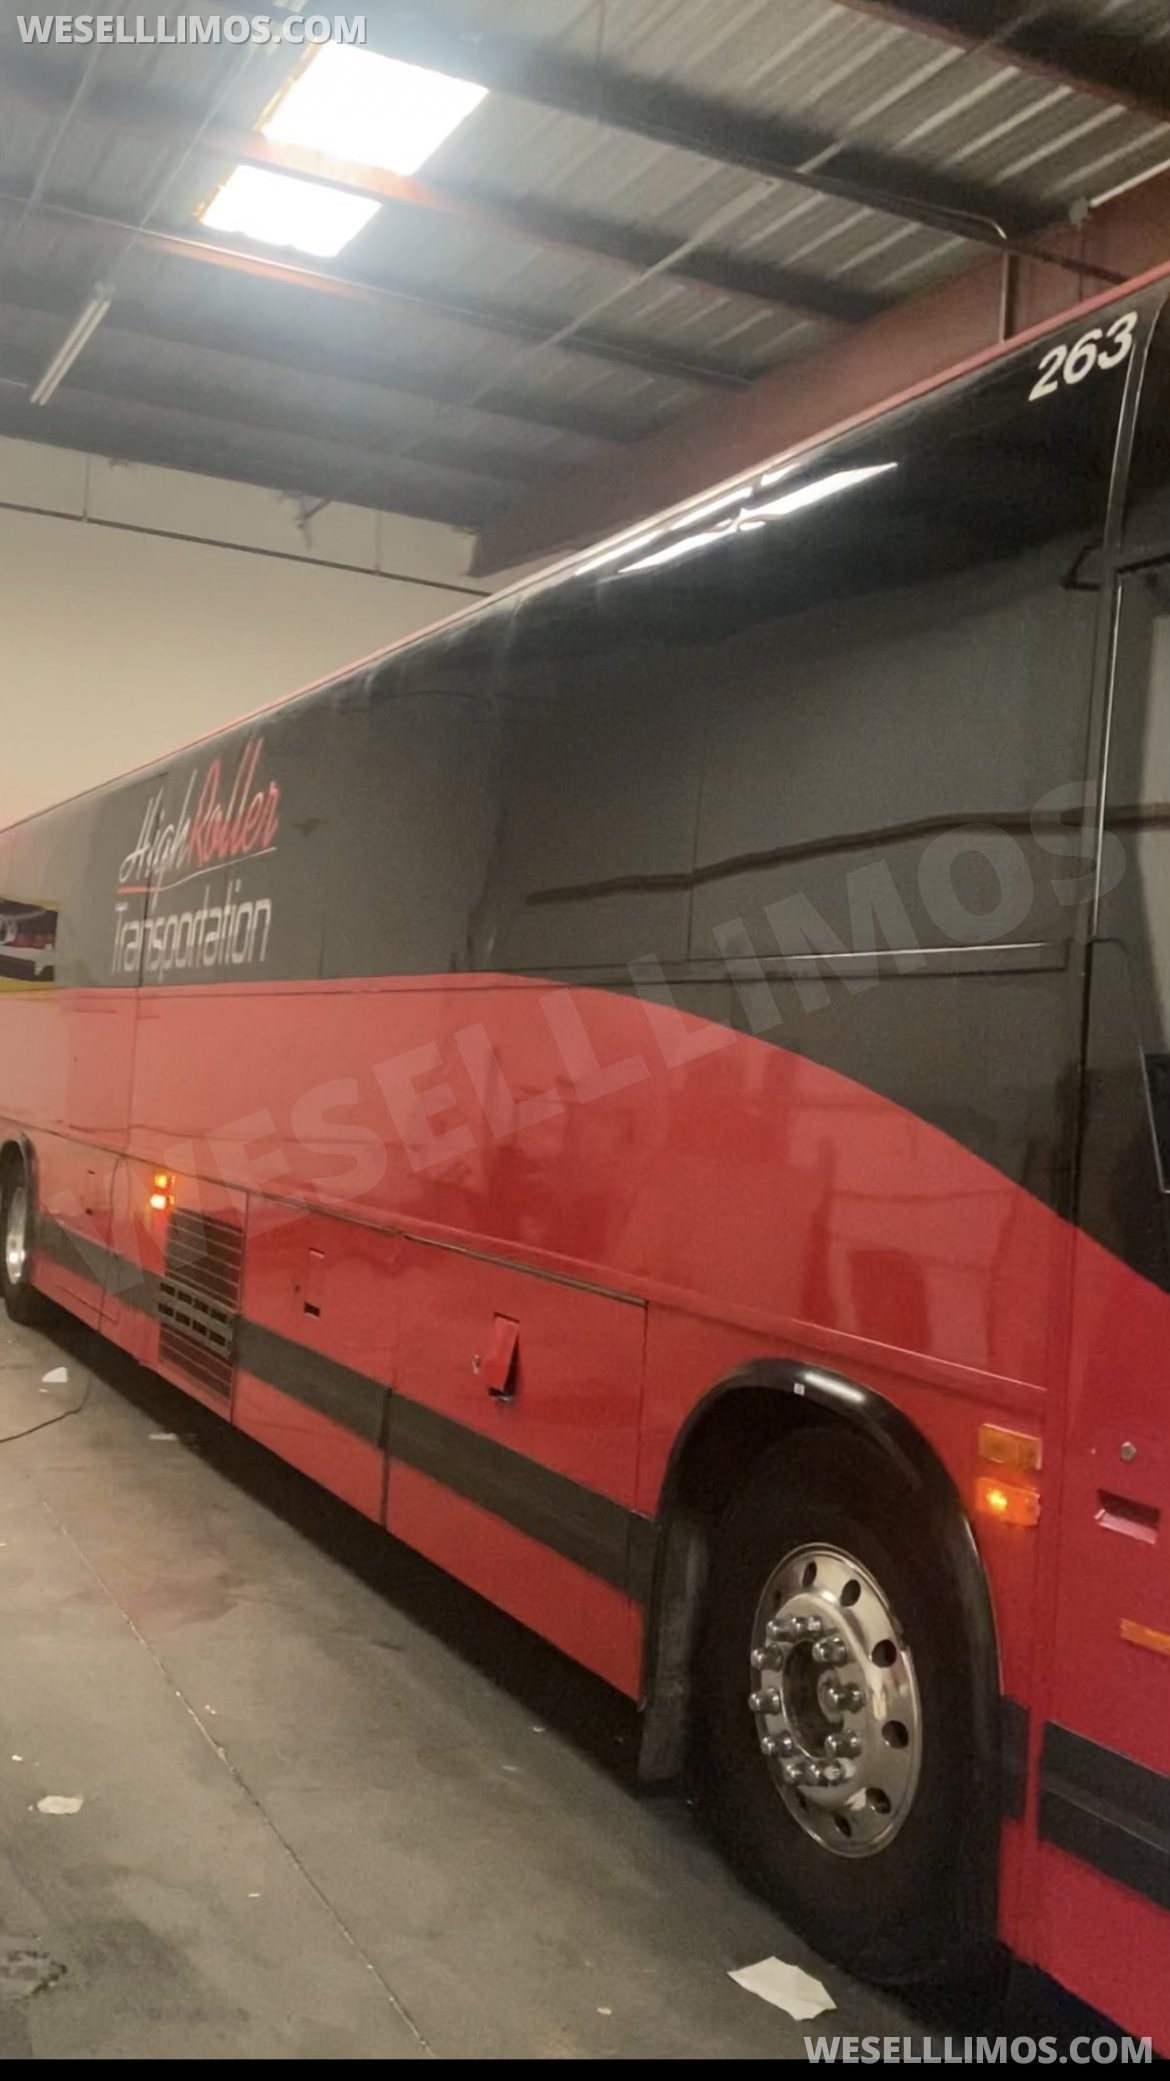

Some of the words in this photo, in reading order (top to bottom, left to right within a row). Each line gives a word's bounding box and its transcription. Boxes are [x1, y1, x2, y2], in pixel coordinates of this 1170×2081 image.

[1028, 311, 1138, 402] 263
[118, 768, 199, 912] High
[112, 878, 272, 982] Transportation
